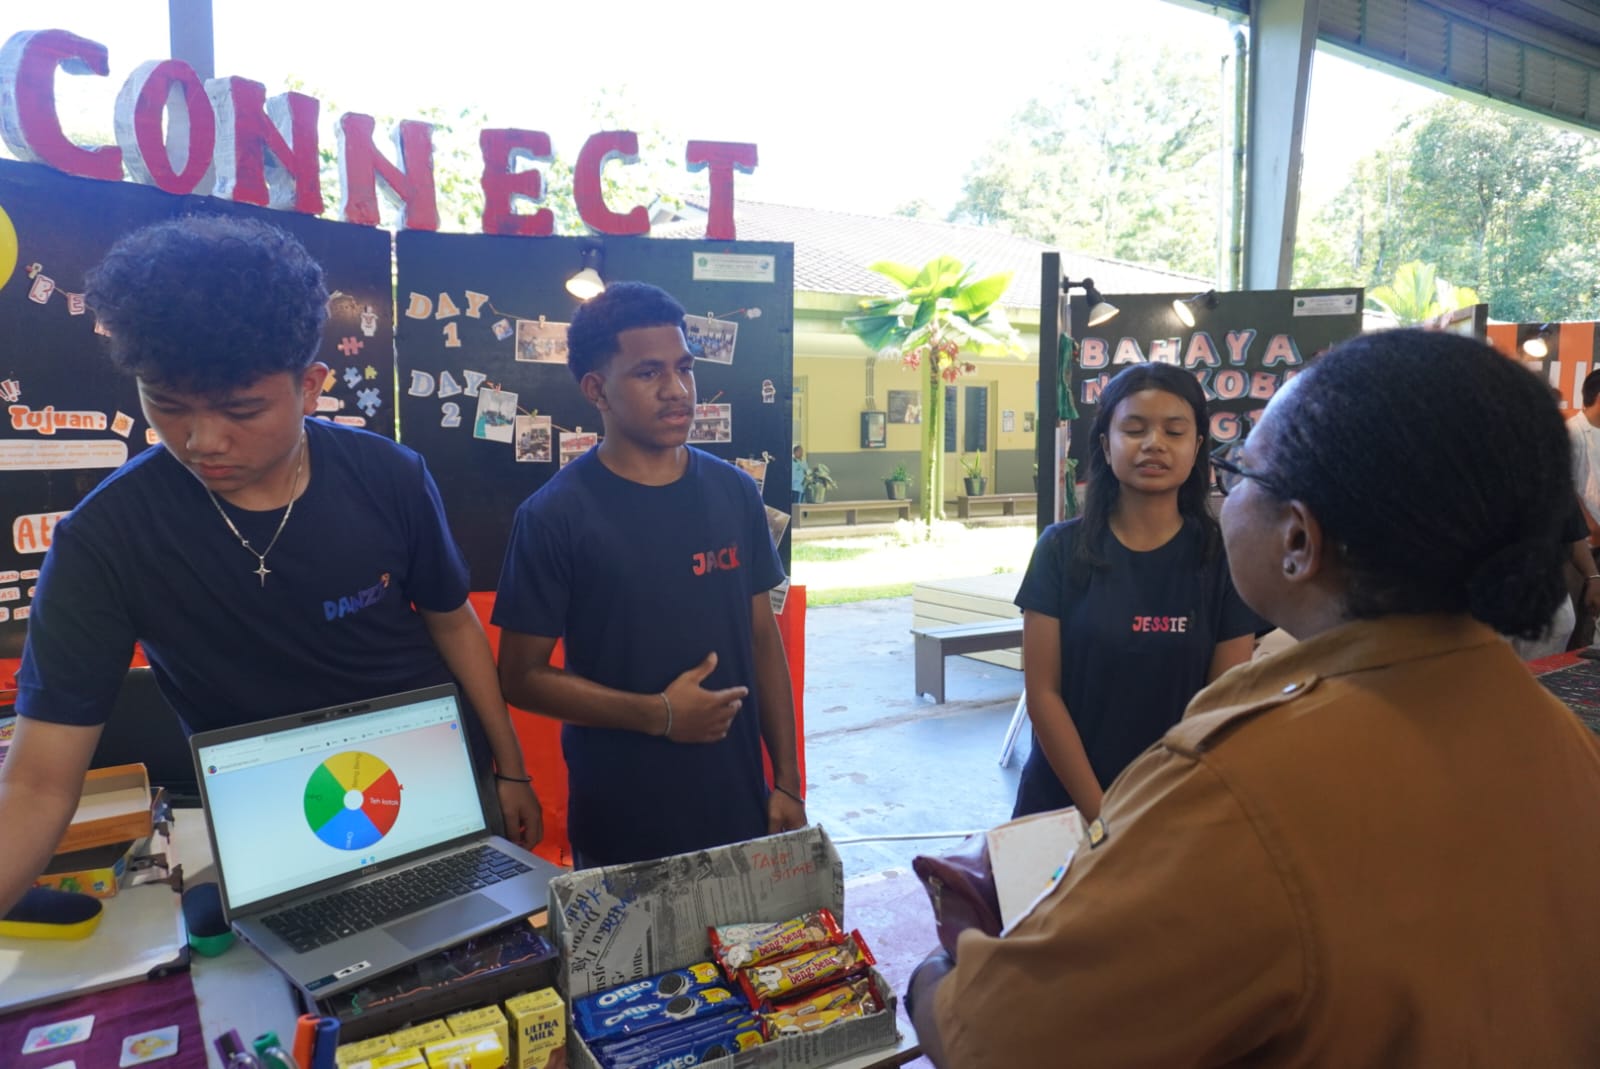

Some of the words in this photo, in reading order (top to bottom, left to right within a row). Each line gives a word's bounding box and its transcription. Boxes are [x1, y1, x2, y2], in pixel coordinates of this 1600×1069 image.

[0, 28, 758, 241] CONNECT
[406, 291, 489, 320] DAY
[443, 322, 461, 347] 1
[1081, 329, 1303, 369] BAHAYA
[408, 369, 487, 398] DAY
[441, 402, 461, 427] 2
[692, 545, 740, 576] JACK
[1132, 616, 1187, 632] JESSIE
[756, 928, 807, 957] beng-beng
[597, 980, 654, 1007] OREO
[604, 1002, 662, 1026] OREO
[524, 1019, 559, 1036] ULTRA
[529, 1030, 554, 1043] MILK
[655, 1053, 697, 1069] REO
